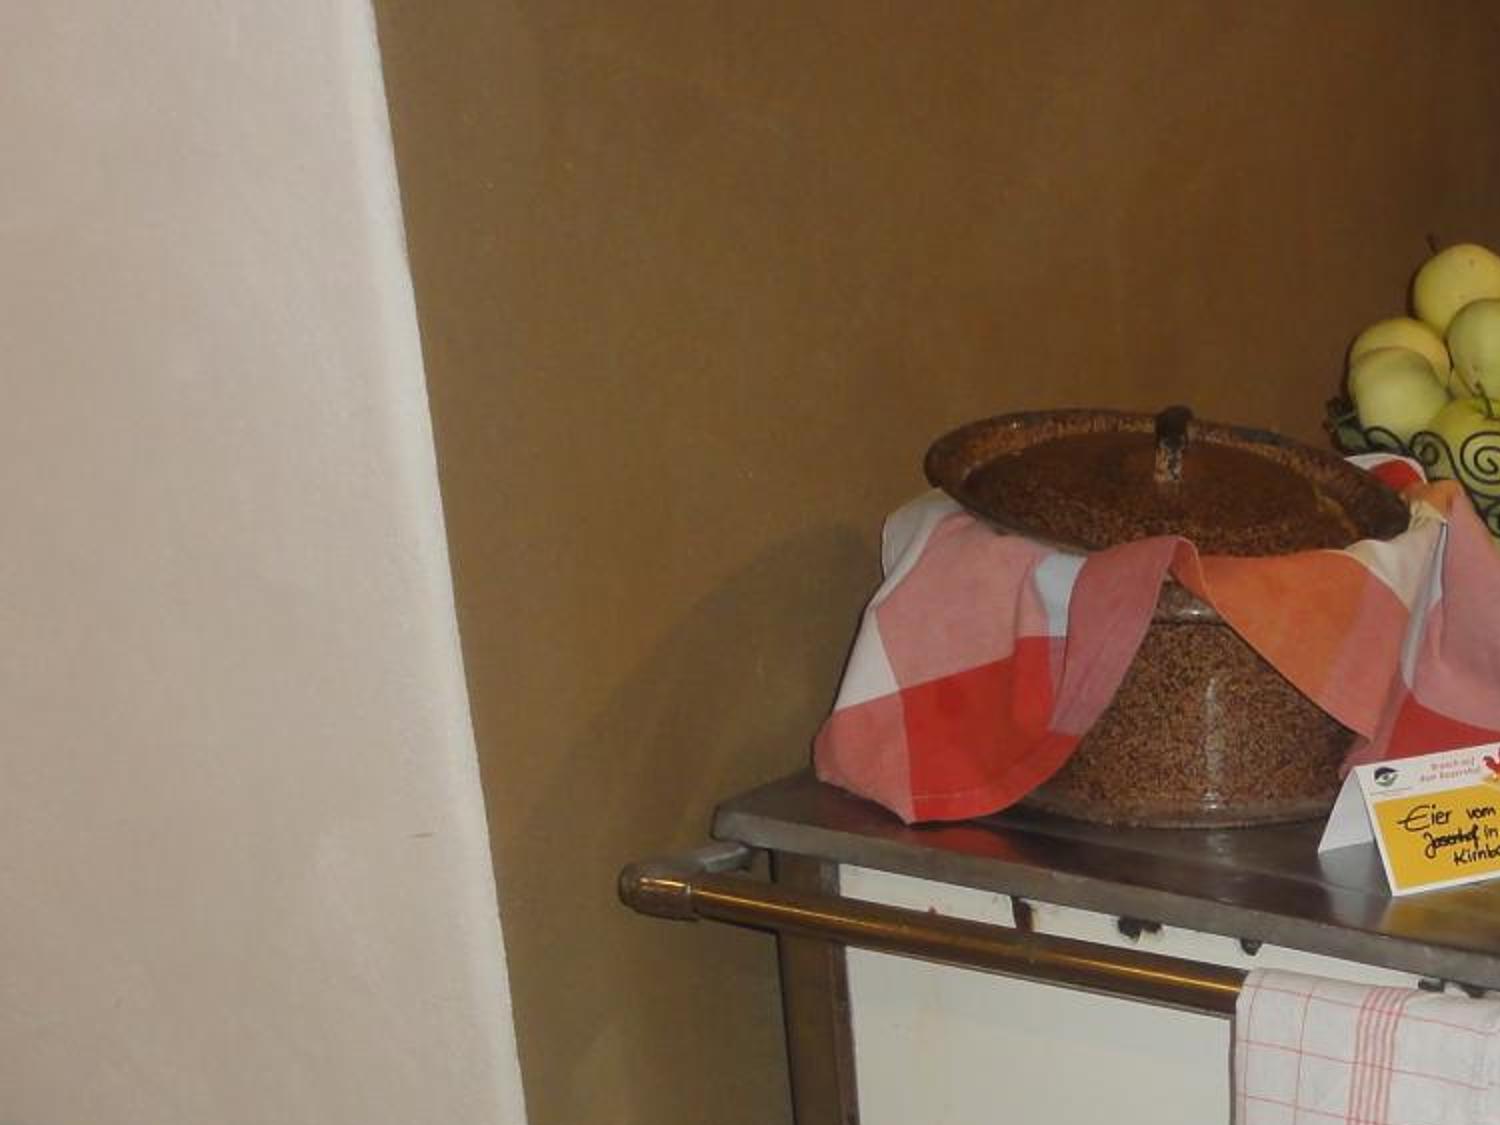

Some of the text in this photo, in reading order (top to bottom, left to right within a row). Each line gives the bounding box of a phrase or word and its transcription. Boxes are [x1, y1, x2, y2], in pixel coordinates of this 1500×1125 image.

[1396, 804, 1497, 832] Eier vom
[1484, 825, 1499, 839] in
